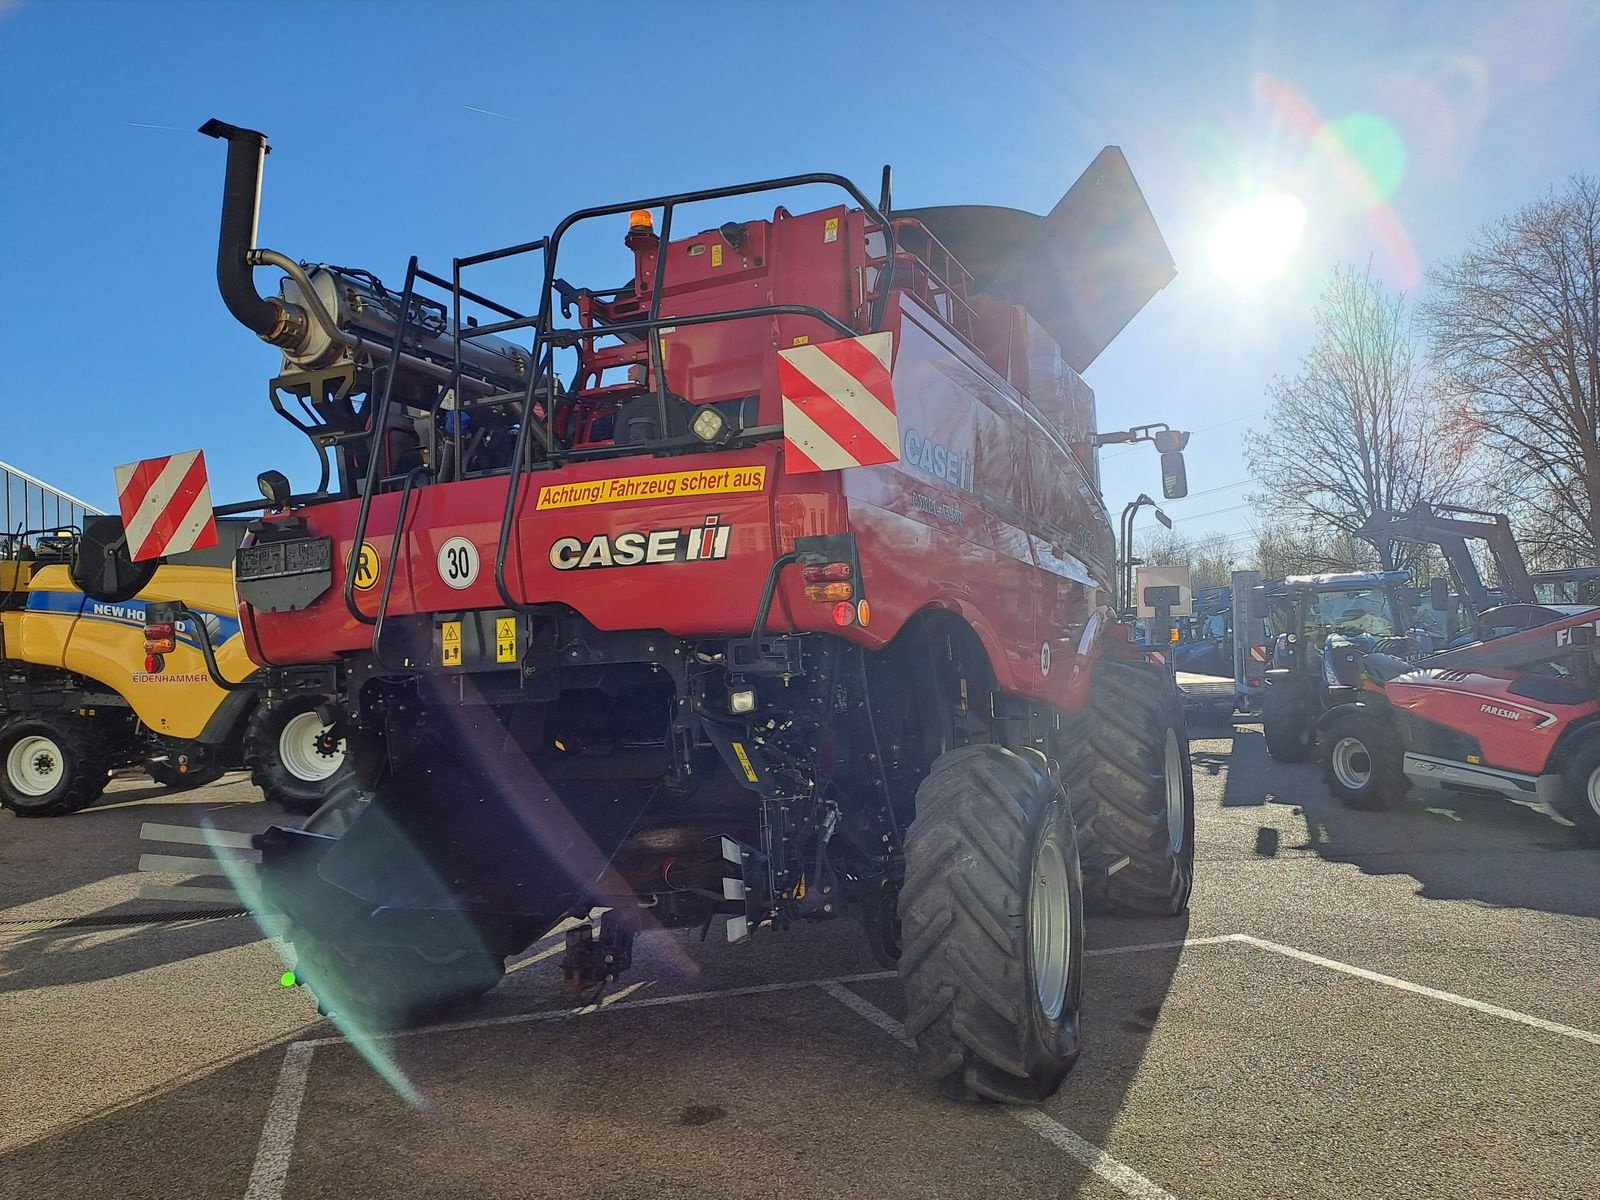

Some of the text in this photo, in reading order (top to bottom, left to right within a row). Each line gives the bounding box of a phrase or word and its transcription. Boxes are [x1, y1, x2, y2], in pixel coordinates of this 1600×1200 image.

[904, 428, 960, 487] CASE
[541, 471, 761, 505] Achtung! Fahrzeug schert aus
[447, 546, 469, 579] 30
[550, 531, 680, 570] CASE
[356, 553, 372, 581] R
[94, 603, 125, 617] NEW
[132, 674, 209, 683] EIDENHAMMER
[1480, 704, 1520, 720] FARESIN
